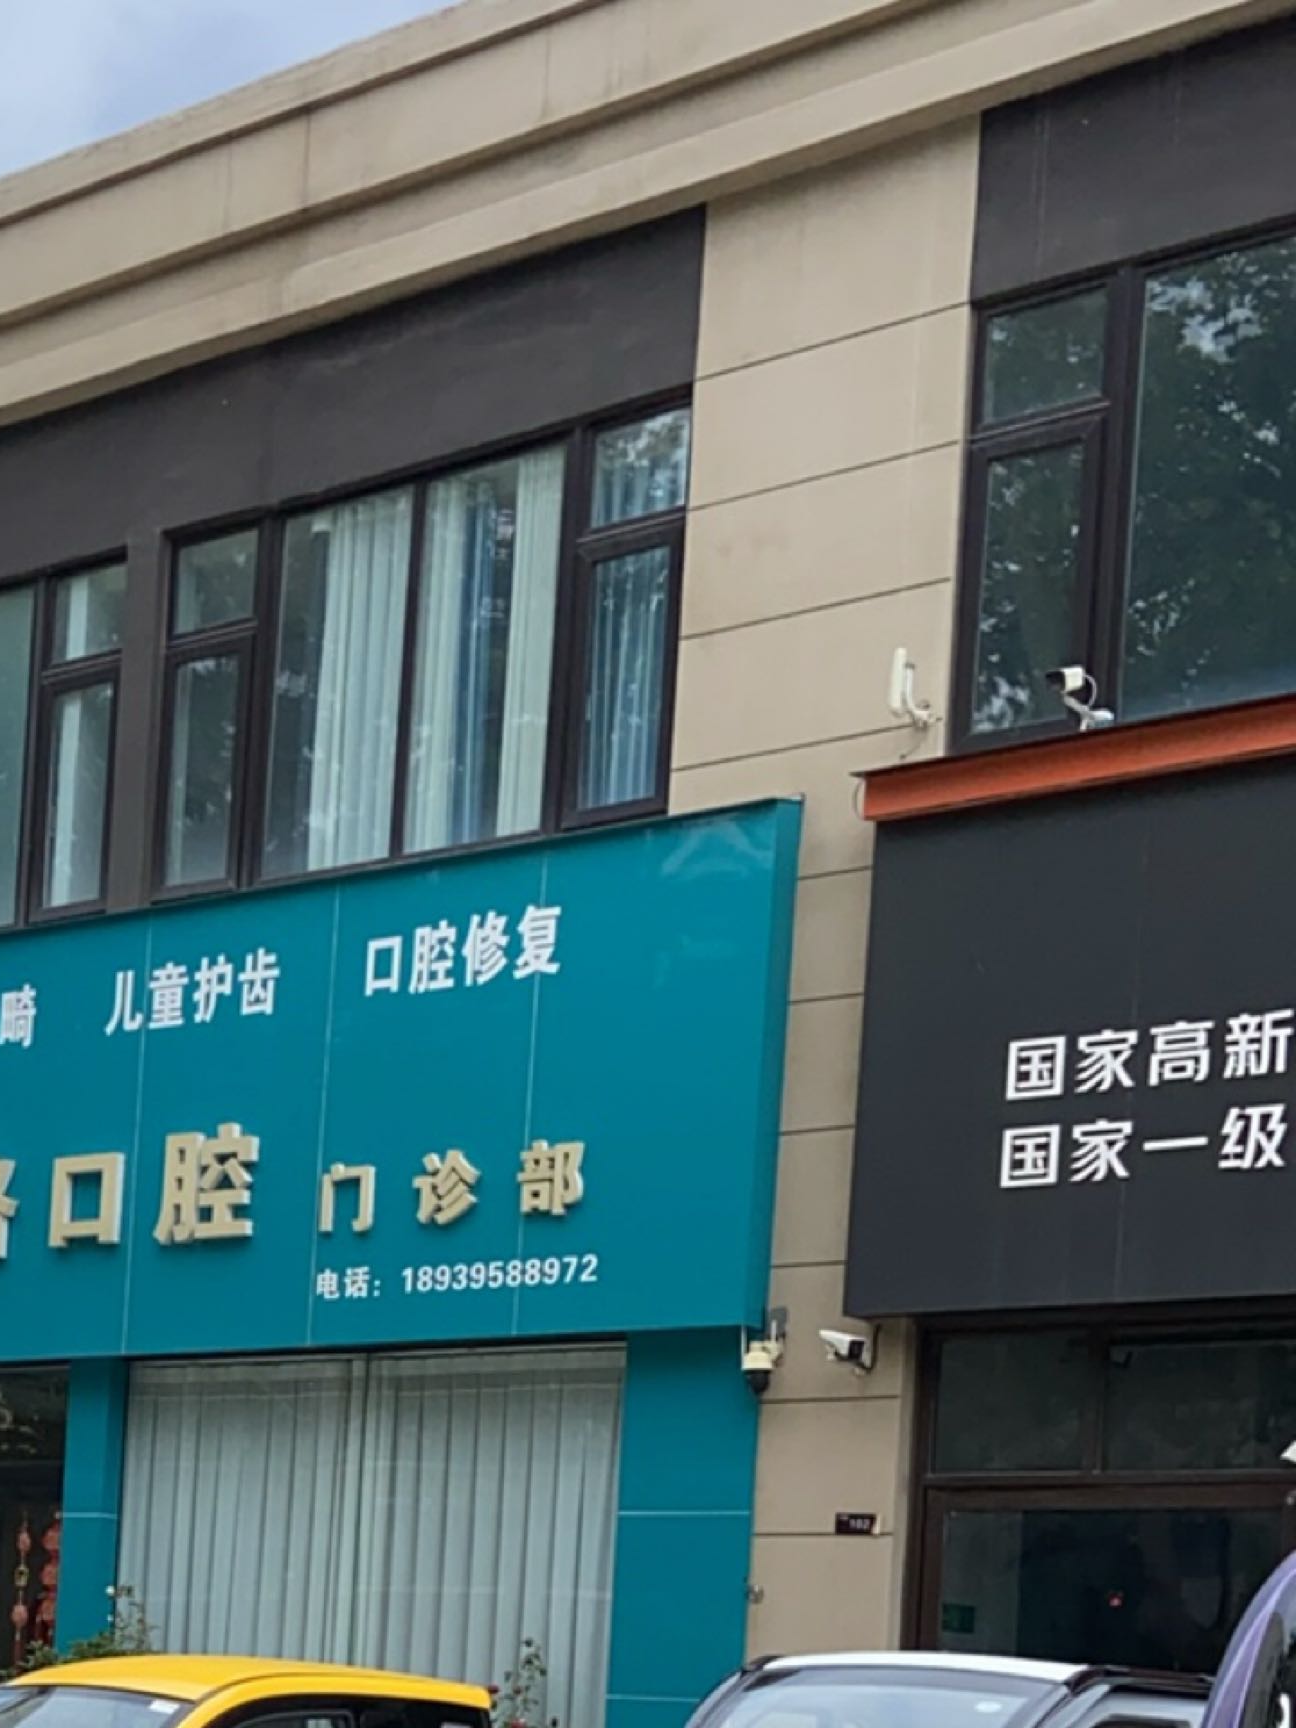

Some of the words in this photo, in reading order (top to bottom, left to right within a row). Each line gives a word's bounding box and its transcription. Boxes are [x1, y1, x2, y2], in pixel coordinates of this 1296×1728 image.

[105, 948, 280, 1035] 儿童护齿
[365, 904, 561, 996] 口腔修复
[1005, 1008, 1295, 1101] 国家高新
[318, 1139, 585, 1234] 门诊部
[999, 1103, 1288, 1189] 国家一级
[401, 1253, 599, 1294] 18939588972
